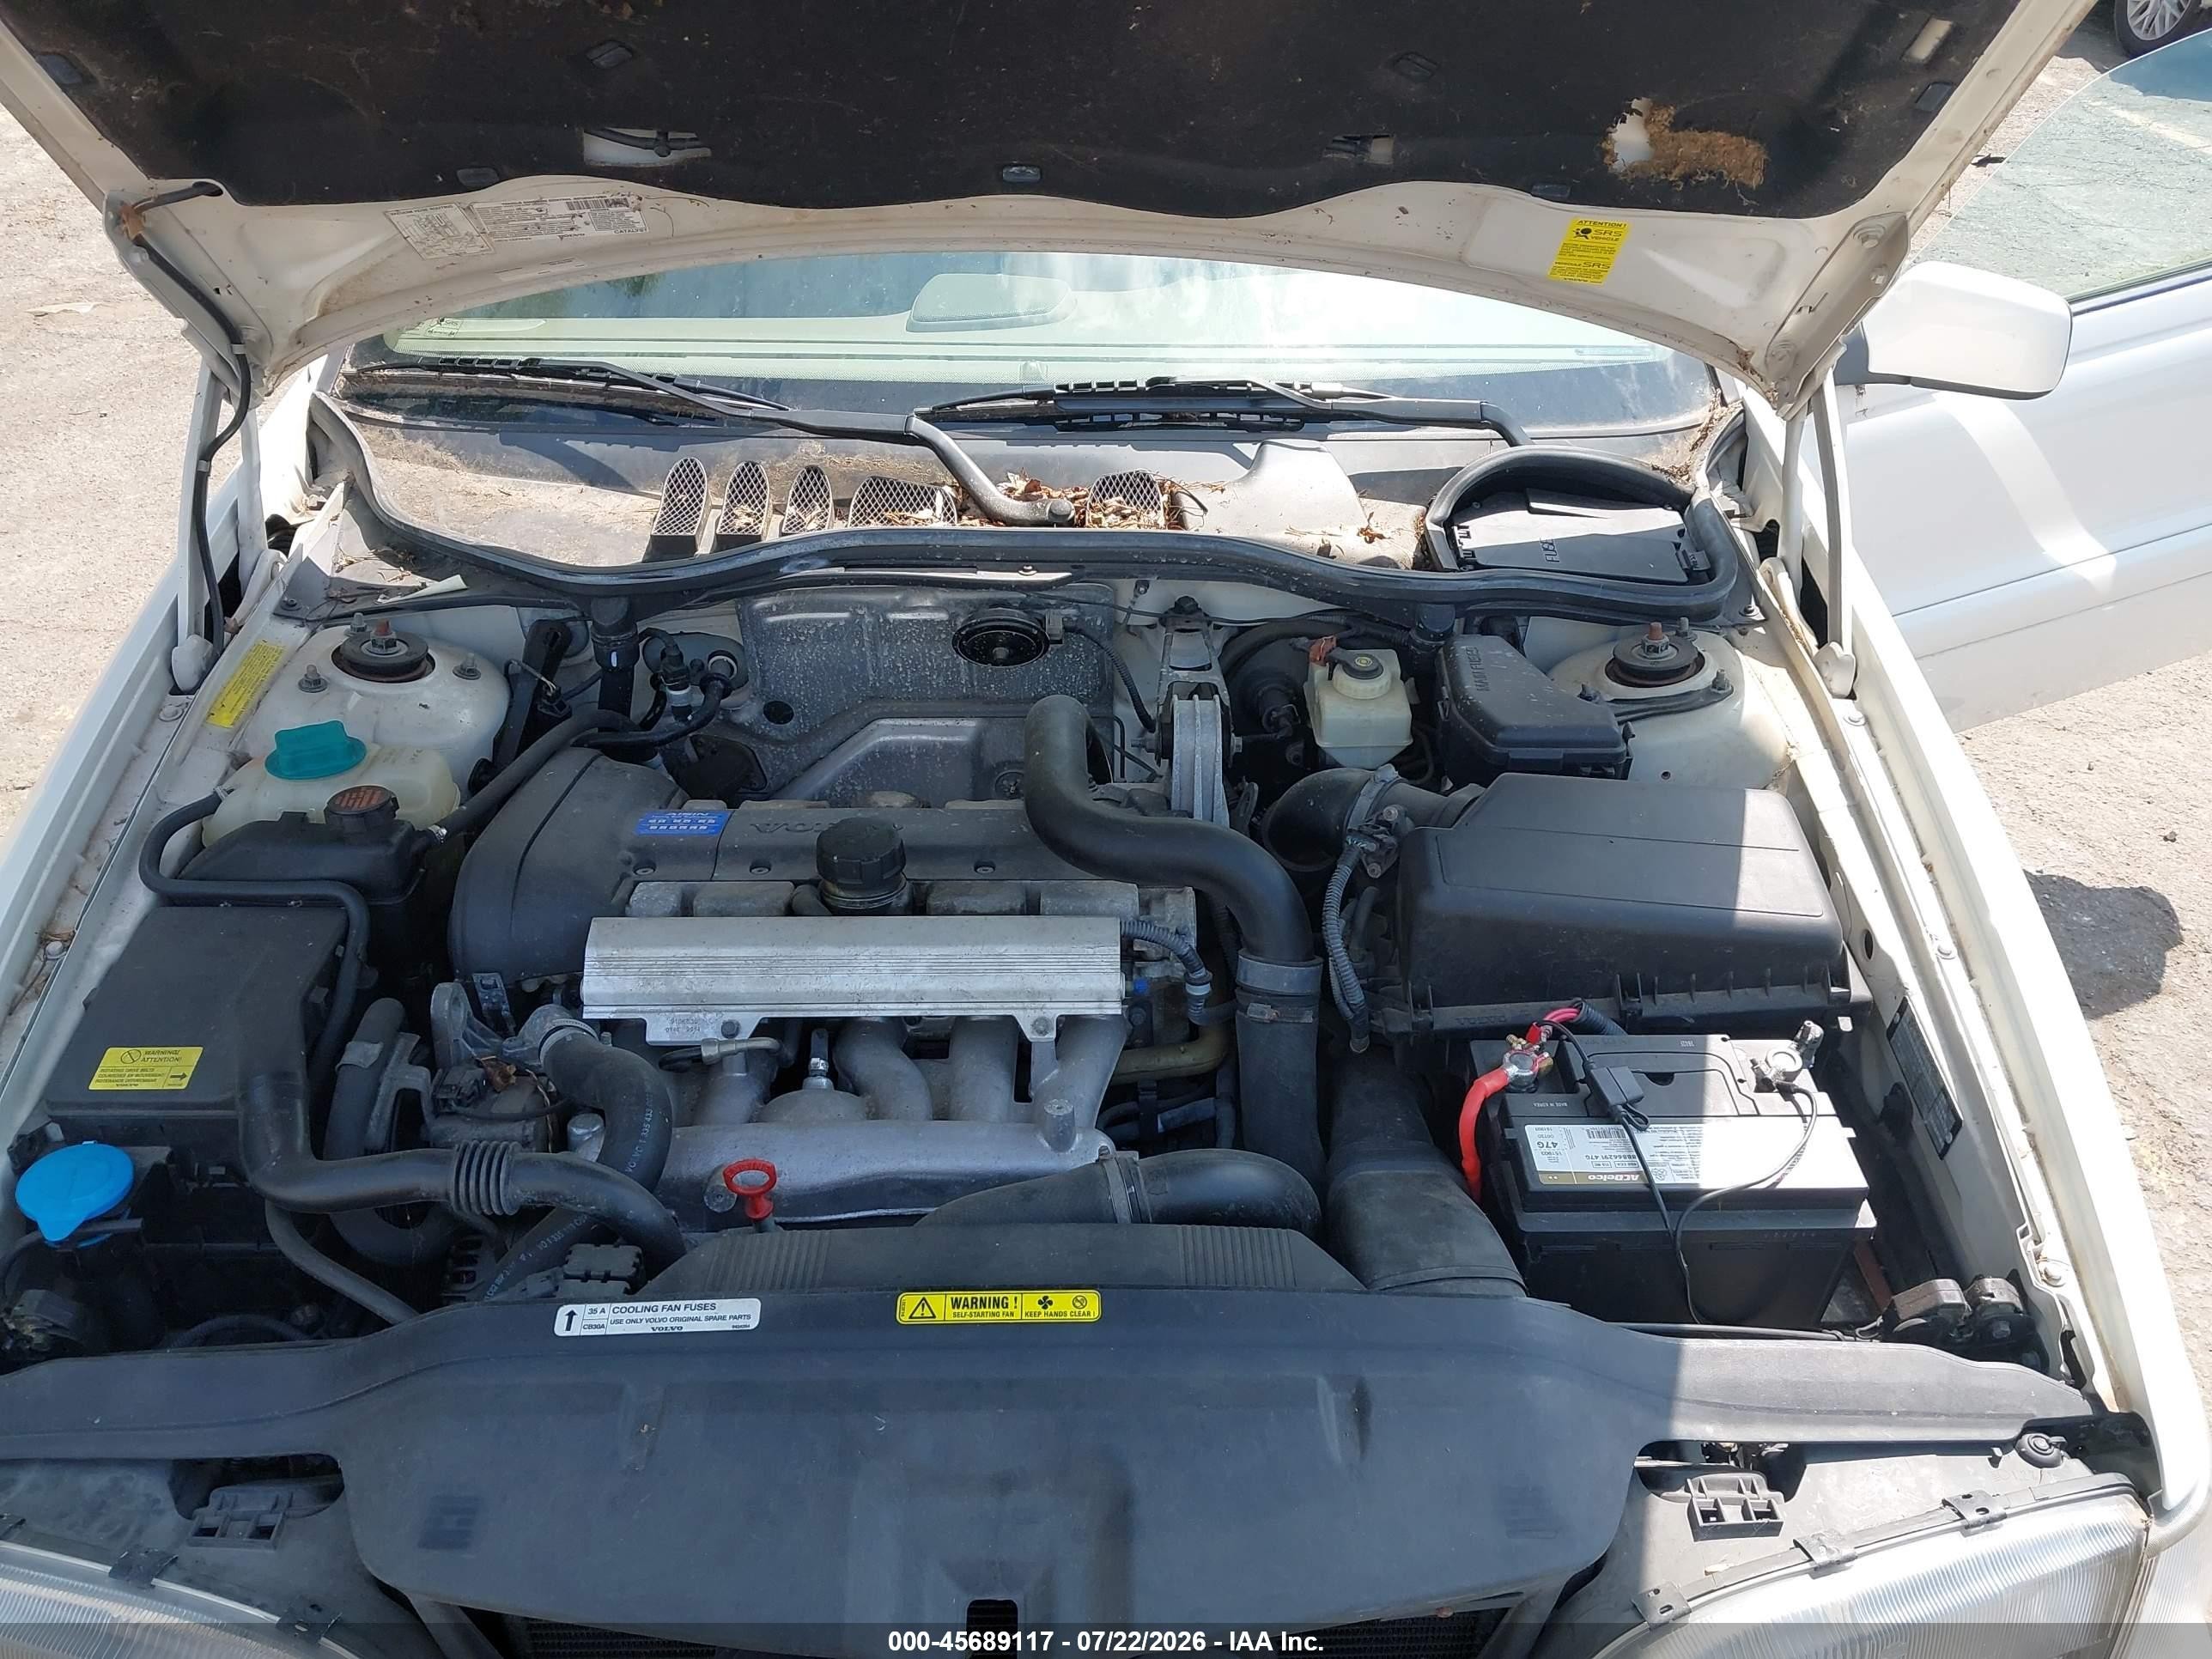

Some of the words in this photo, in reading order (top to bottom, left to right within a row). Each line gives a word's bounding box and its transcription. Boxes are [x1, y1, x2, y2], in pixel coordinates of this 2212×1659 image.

[1593, 228, 1622, 237] SRS
[611, 1305, 659, 1315] COOLING
[661, 1304, 681, 1312] FAN
[684, 1303, 717, 1311] FUSES
[951, 1296, 1009, 1310] WARNING
[1013, 1296, 1018, 1310] !
